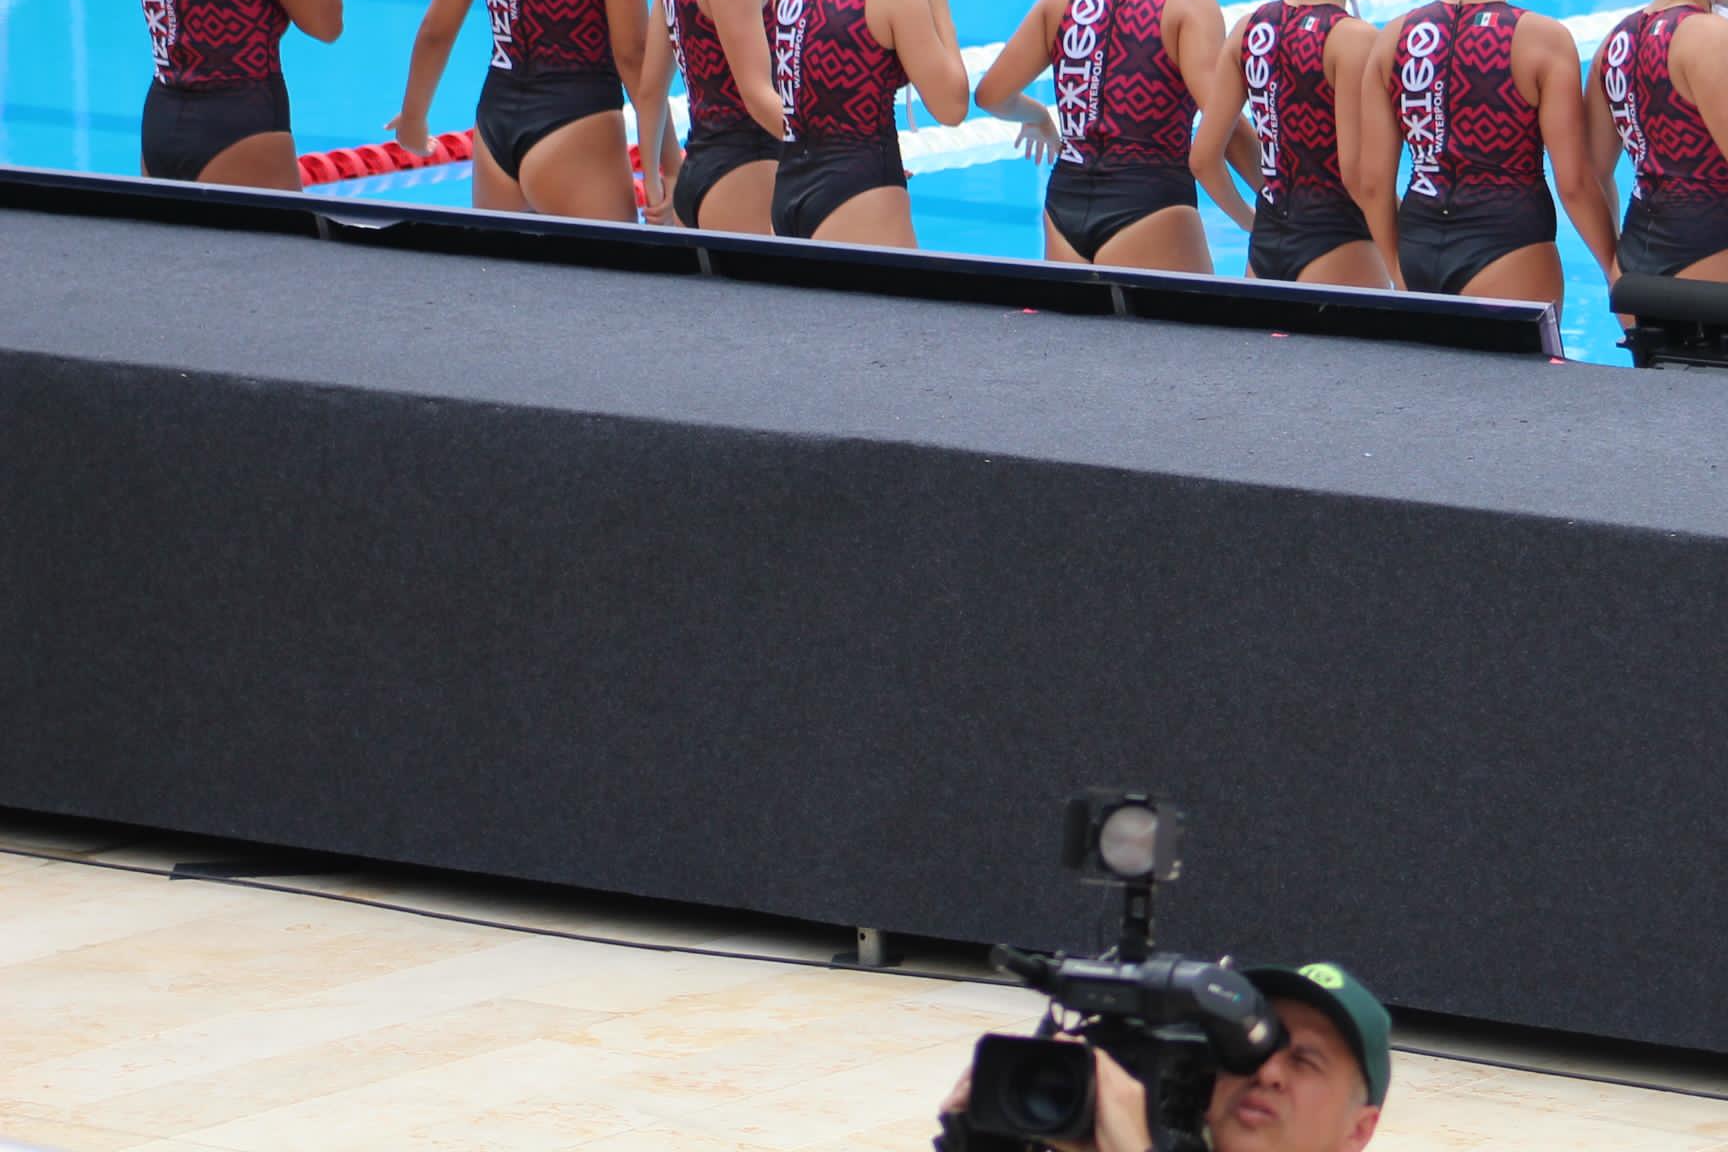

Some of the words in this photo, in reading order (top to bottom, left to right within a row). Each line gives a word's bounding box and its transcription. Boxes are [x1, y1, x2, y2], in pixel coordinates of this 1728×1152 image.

[794, 17, 807, 90] WATERPOLO
[1088, 49, 1105, 120] WATERPOLO
[1434, 80, 1446, 154] WATERPOLO
